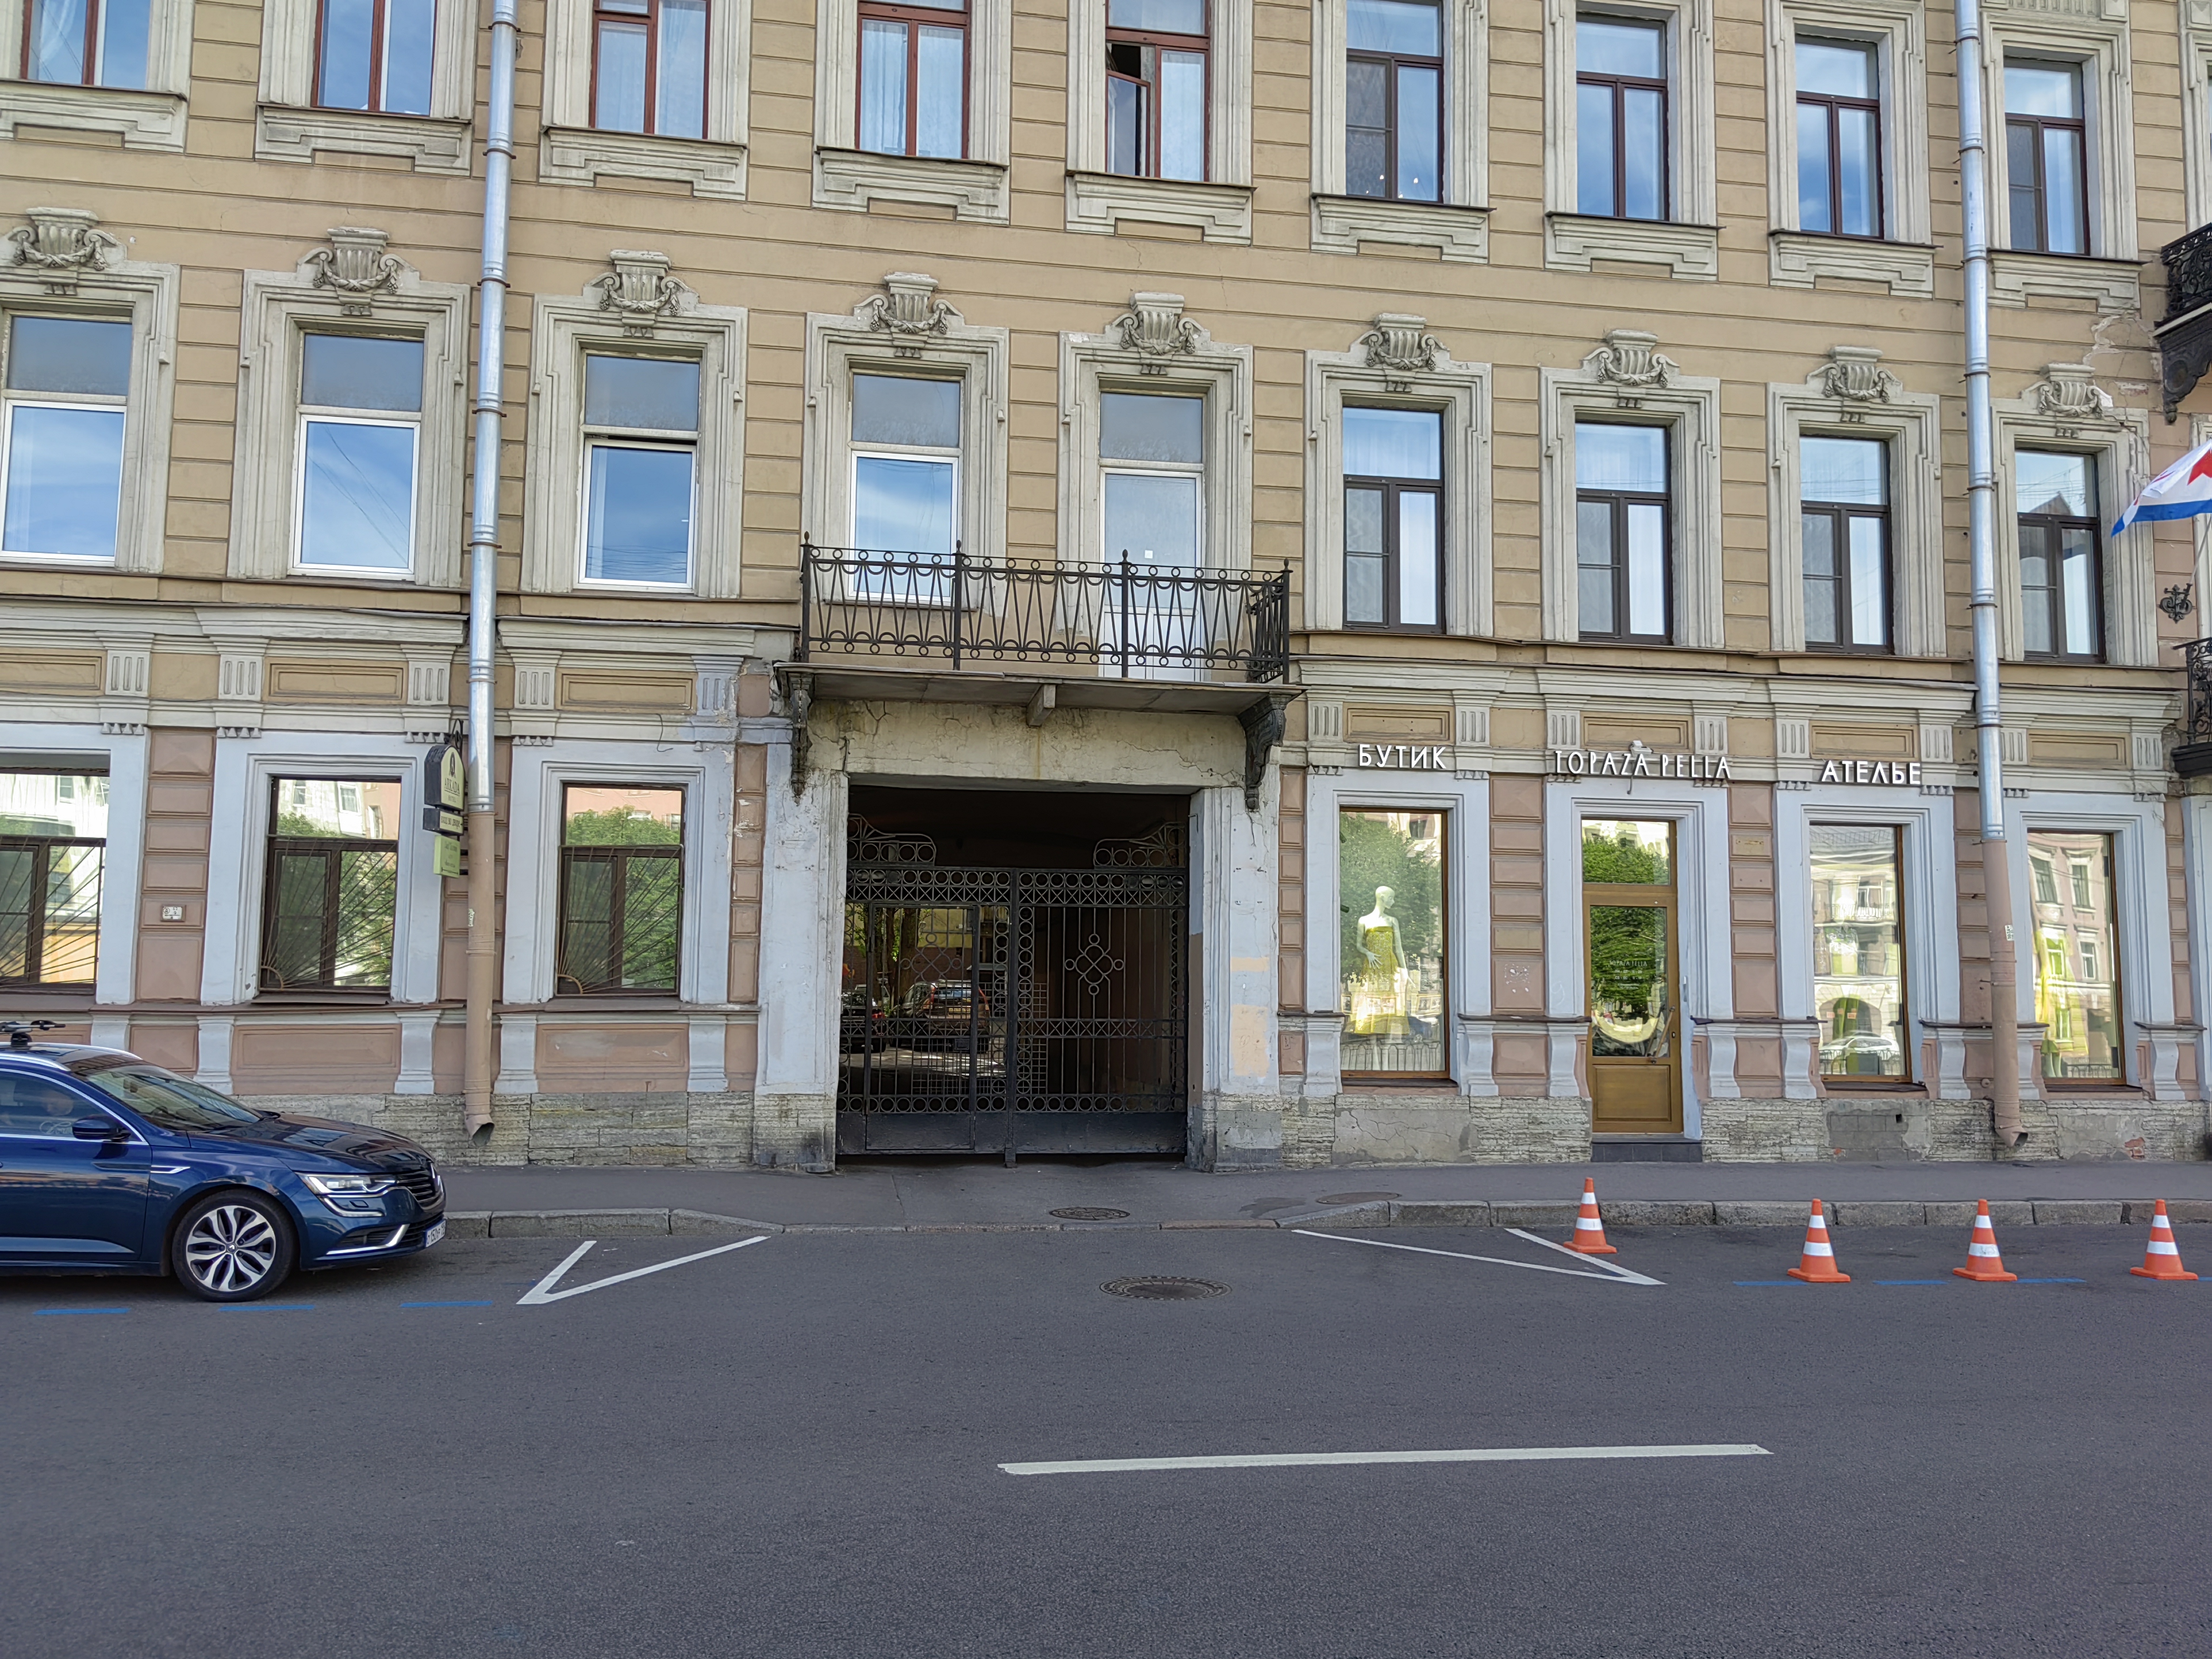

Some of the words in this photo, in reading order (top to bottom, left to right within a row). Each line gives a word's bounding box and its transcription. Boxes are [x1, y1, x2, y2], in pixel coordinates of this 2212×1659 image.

[1359, 744, 1447, 769] БУТИК
[1555, 750, 1649, 776] TOPAZA
[1662, 754, 1731, 779] PELLA
[1821, 760, 1921, 785] АТЕЛЬЕ
[444, 778, 460, 794] ARKADA
[1340, 855, 1375, 868] OPAZA
